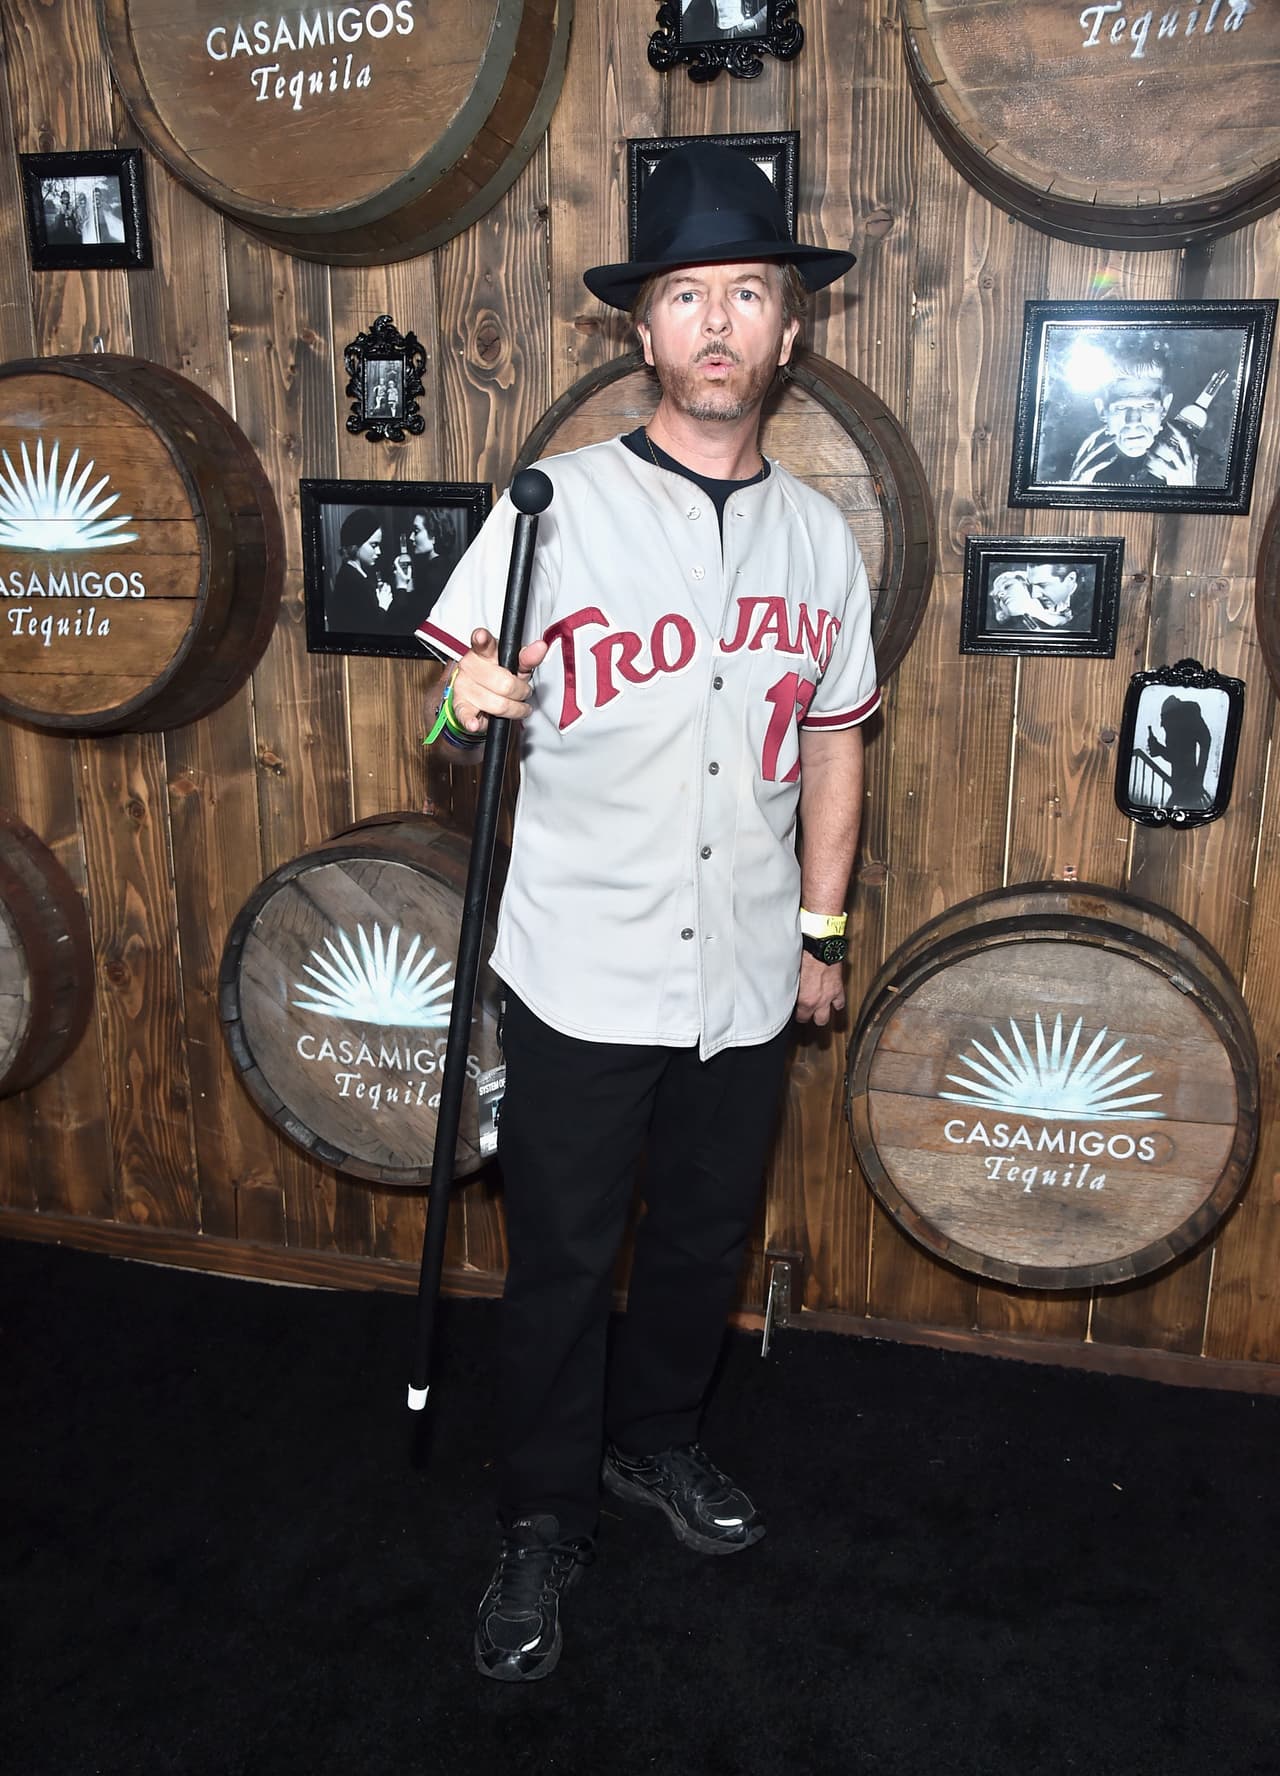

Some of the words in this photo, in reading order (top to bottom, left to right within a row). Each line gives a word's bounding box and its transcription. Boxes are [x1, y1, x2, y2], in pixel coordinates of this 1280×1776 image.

[206, 0, 415, 61] CASAMIGOS
[1080, 0, 1248, 59] Tequila
[250, 53, 372, 111] Tequila
[7, 606, 111, 647] Tequila
[296, 1034, 482, 1081] CASAMIGS
[334, 1072, 442, 1111] Tequila
[479, 1080, 499, 1096] SYSTEM
[943, 1119, 1156, 1161] CASAMIGOS
[984, 1156, 1107, 1194] Tequila
